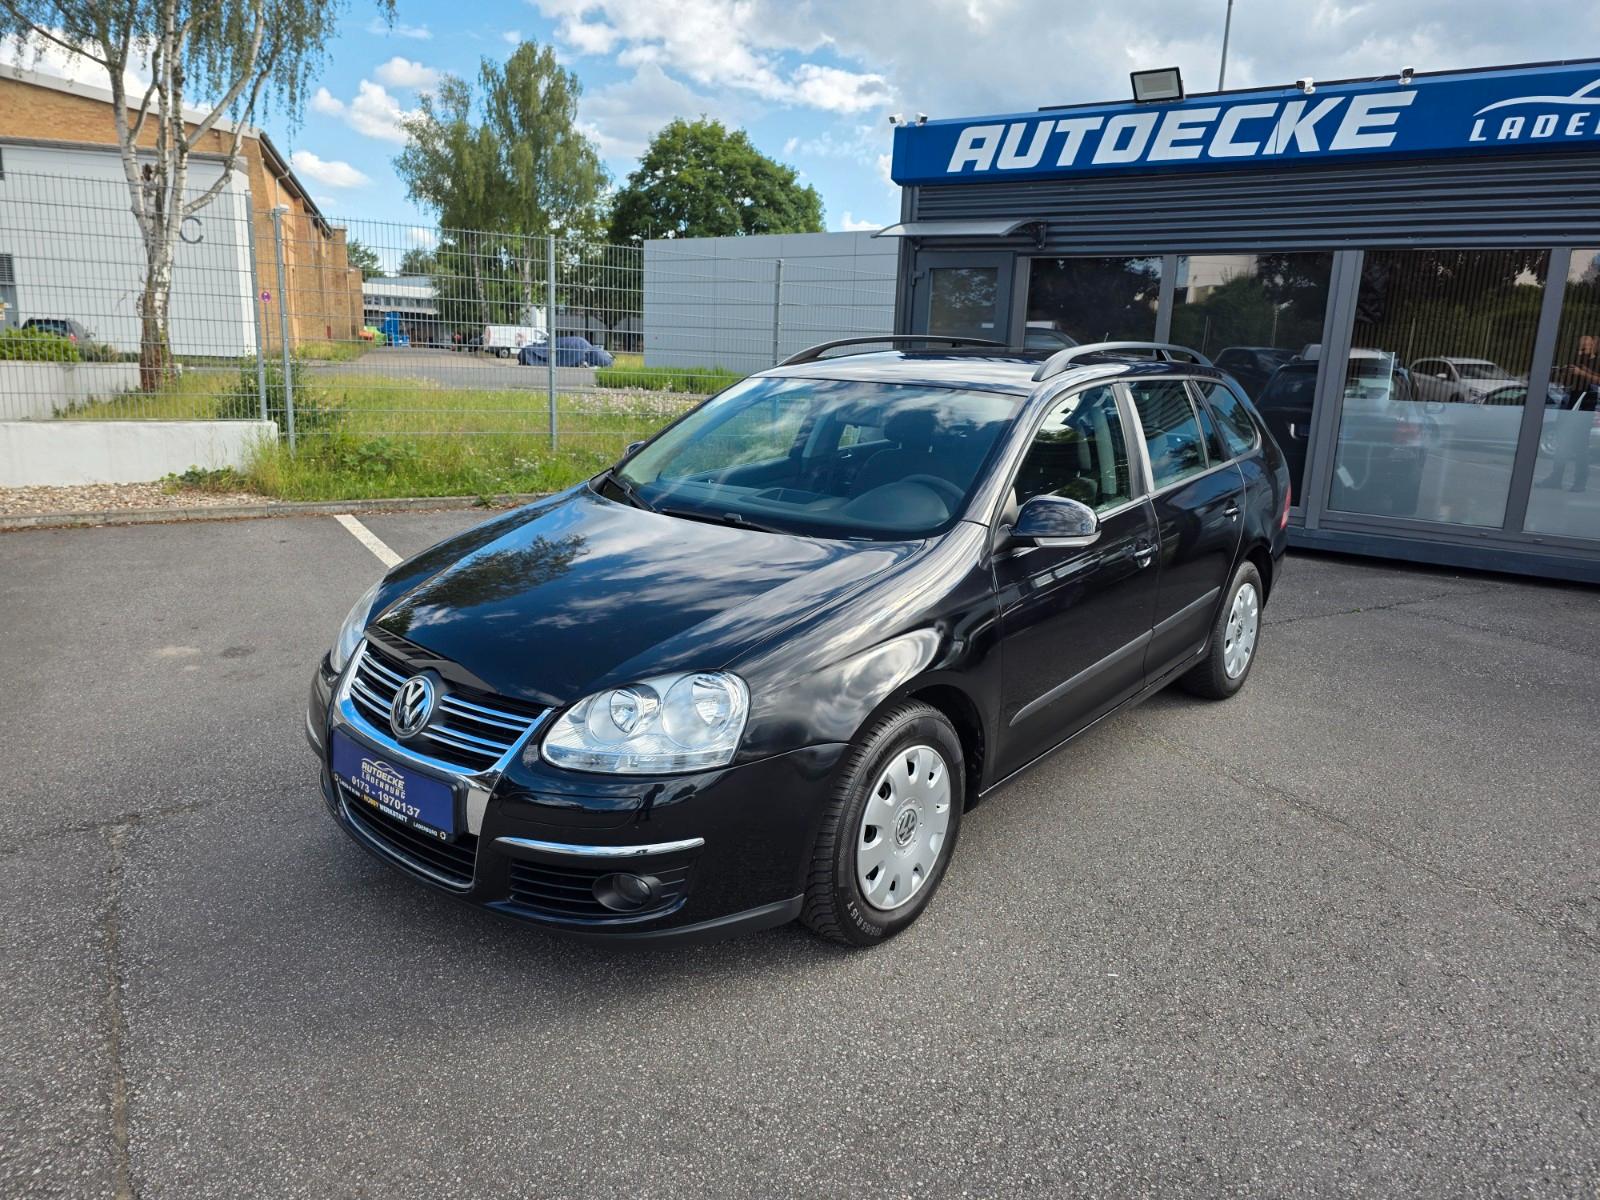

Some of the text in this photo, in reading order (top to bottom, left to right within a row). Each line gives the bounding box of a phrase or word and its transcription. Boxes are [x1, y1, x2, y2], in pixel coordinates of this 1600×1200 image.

[946, 91, 1418, 174] AUTOECKE
[1468, 111, 1600, 142] LADE
[361, 761, 405, 790] AUTOECKE
[351, 775, 370, 794] 0173
[378, 790, 420, 818] 1970137
